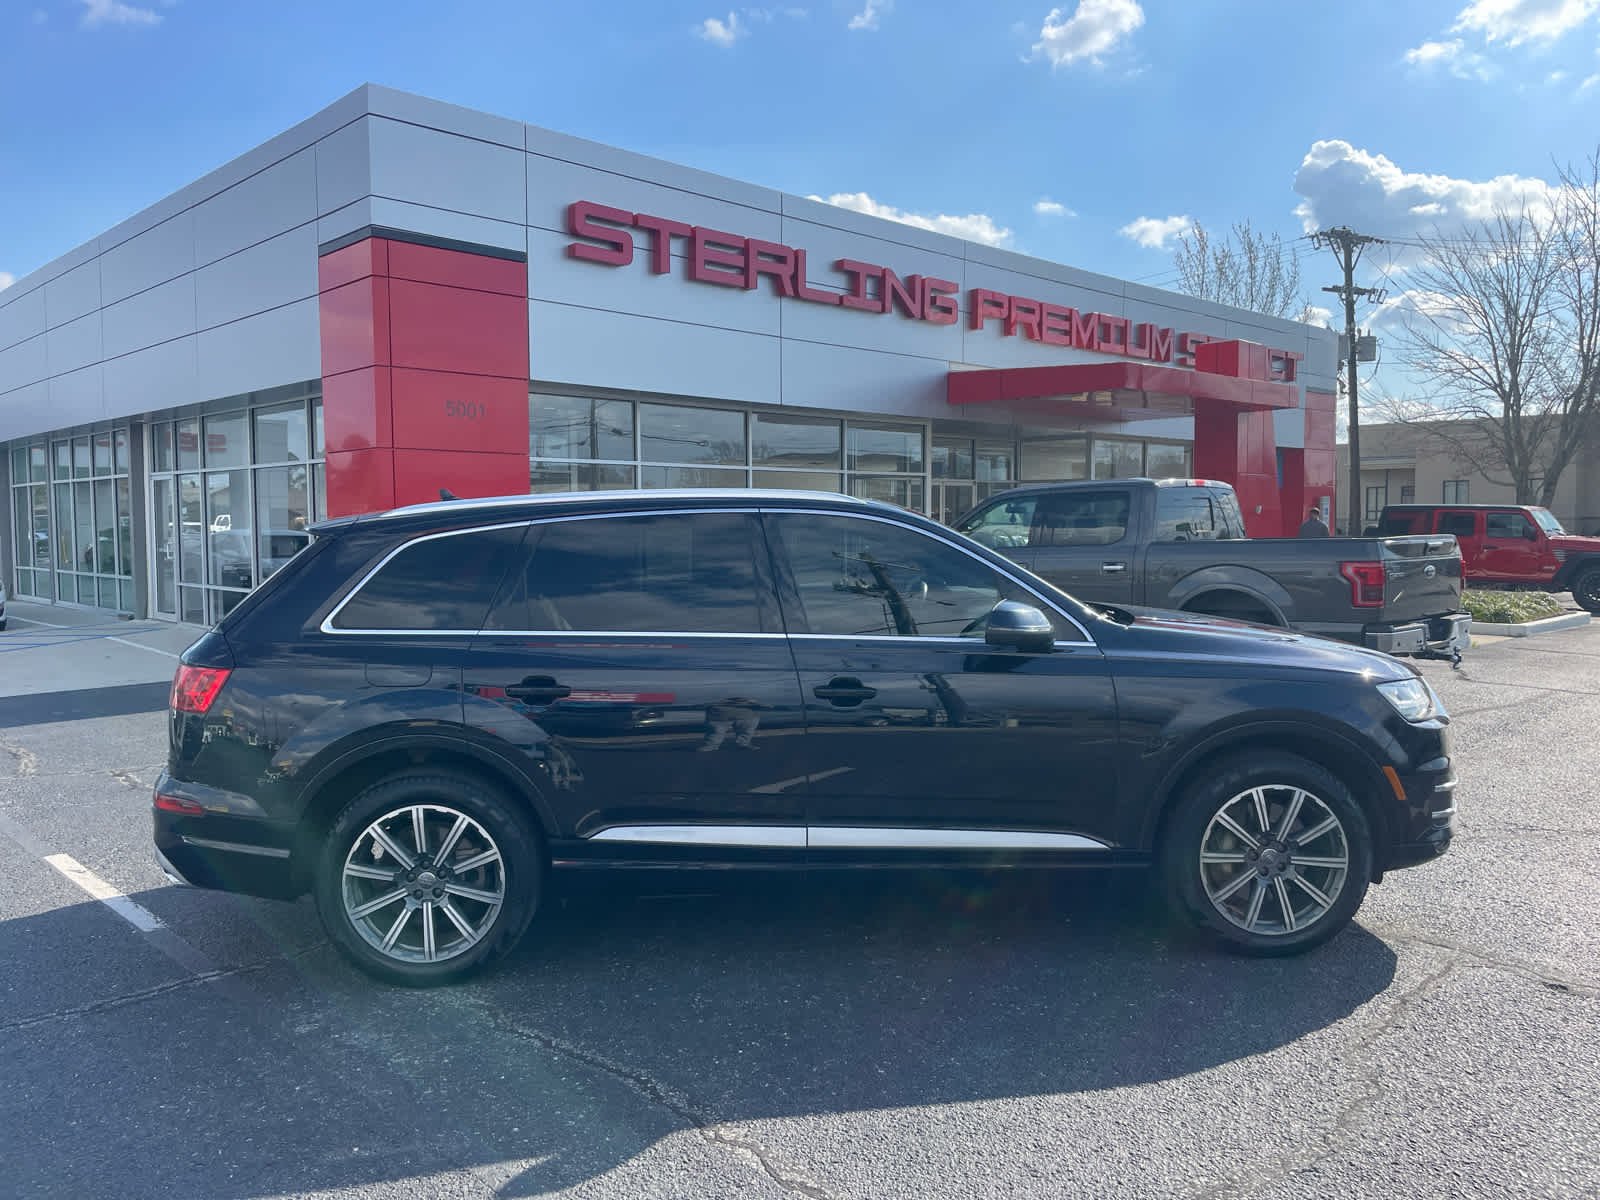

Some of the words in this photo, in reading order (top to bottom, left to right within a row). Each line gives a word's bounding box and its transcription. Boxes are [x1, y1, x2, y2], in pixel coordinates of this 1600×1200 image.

[567, 200, 960, 325] STERLING
[969, 288, 1176, 362] PREMIUM
[445, 399, 486, 421] 5001
